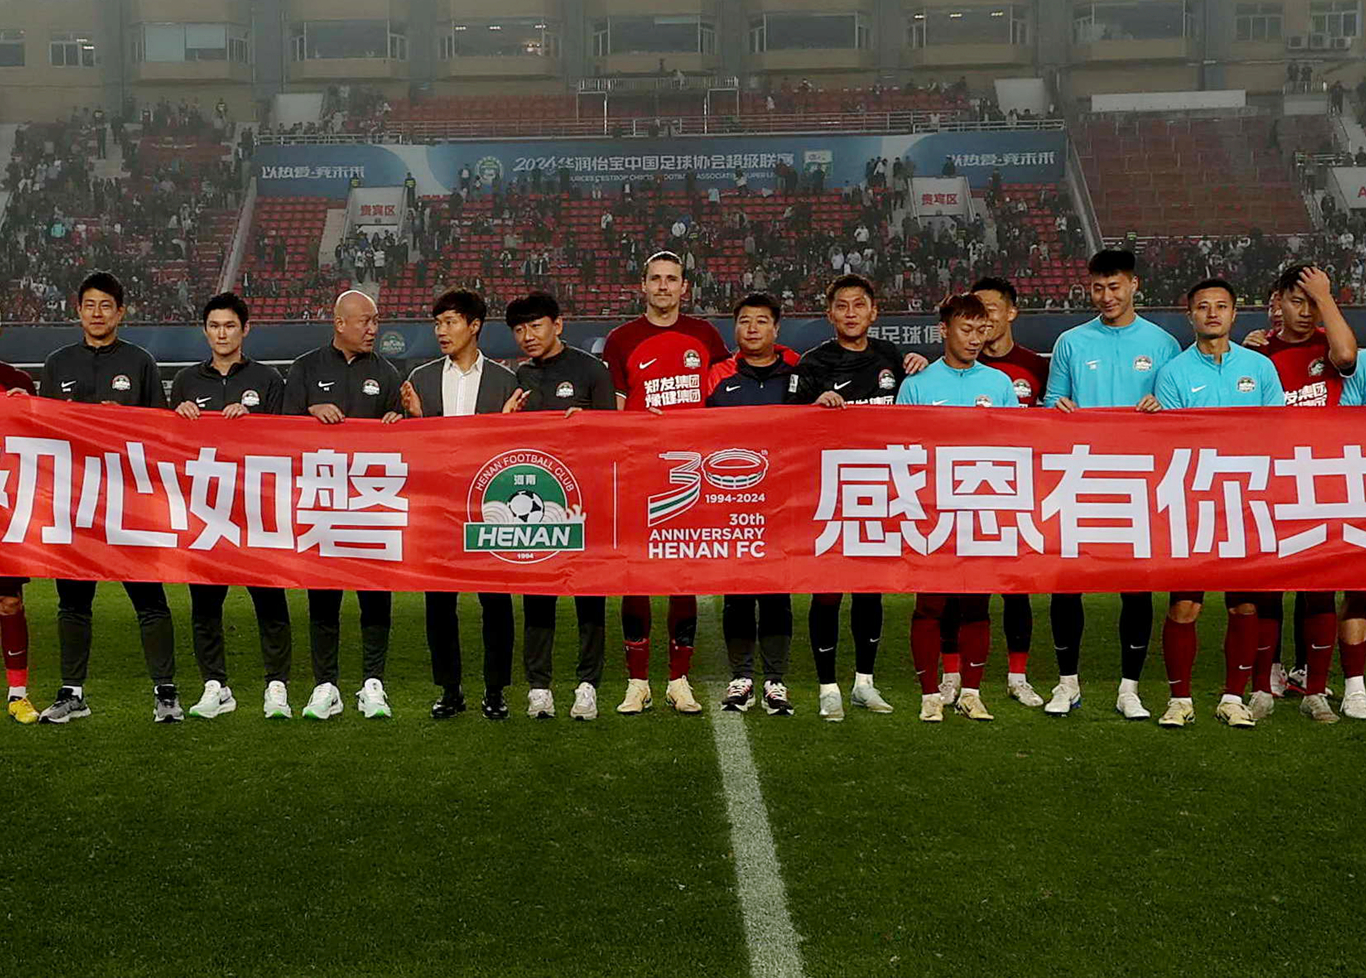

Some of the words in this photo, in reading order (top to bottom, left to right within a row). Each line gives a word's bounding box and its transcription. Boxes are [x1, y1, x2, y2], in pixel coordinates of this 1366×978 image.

[475, 461, 503, 492] HENAN
[502, 453, 554, 471] FOOTBALL
[554, 467, 575, 492] CLUB
[705, 493, 766, 503] 1994-2024
[729, 513, 765, 526] 30th
[477, 526, 570, 547] HENAN
[649, 527, 765, 541] ANNIVERSARY
[648, 542, 728, 559] HENAN
[736, 541, 766, 558] FC
